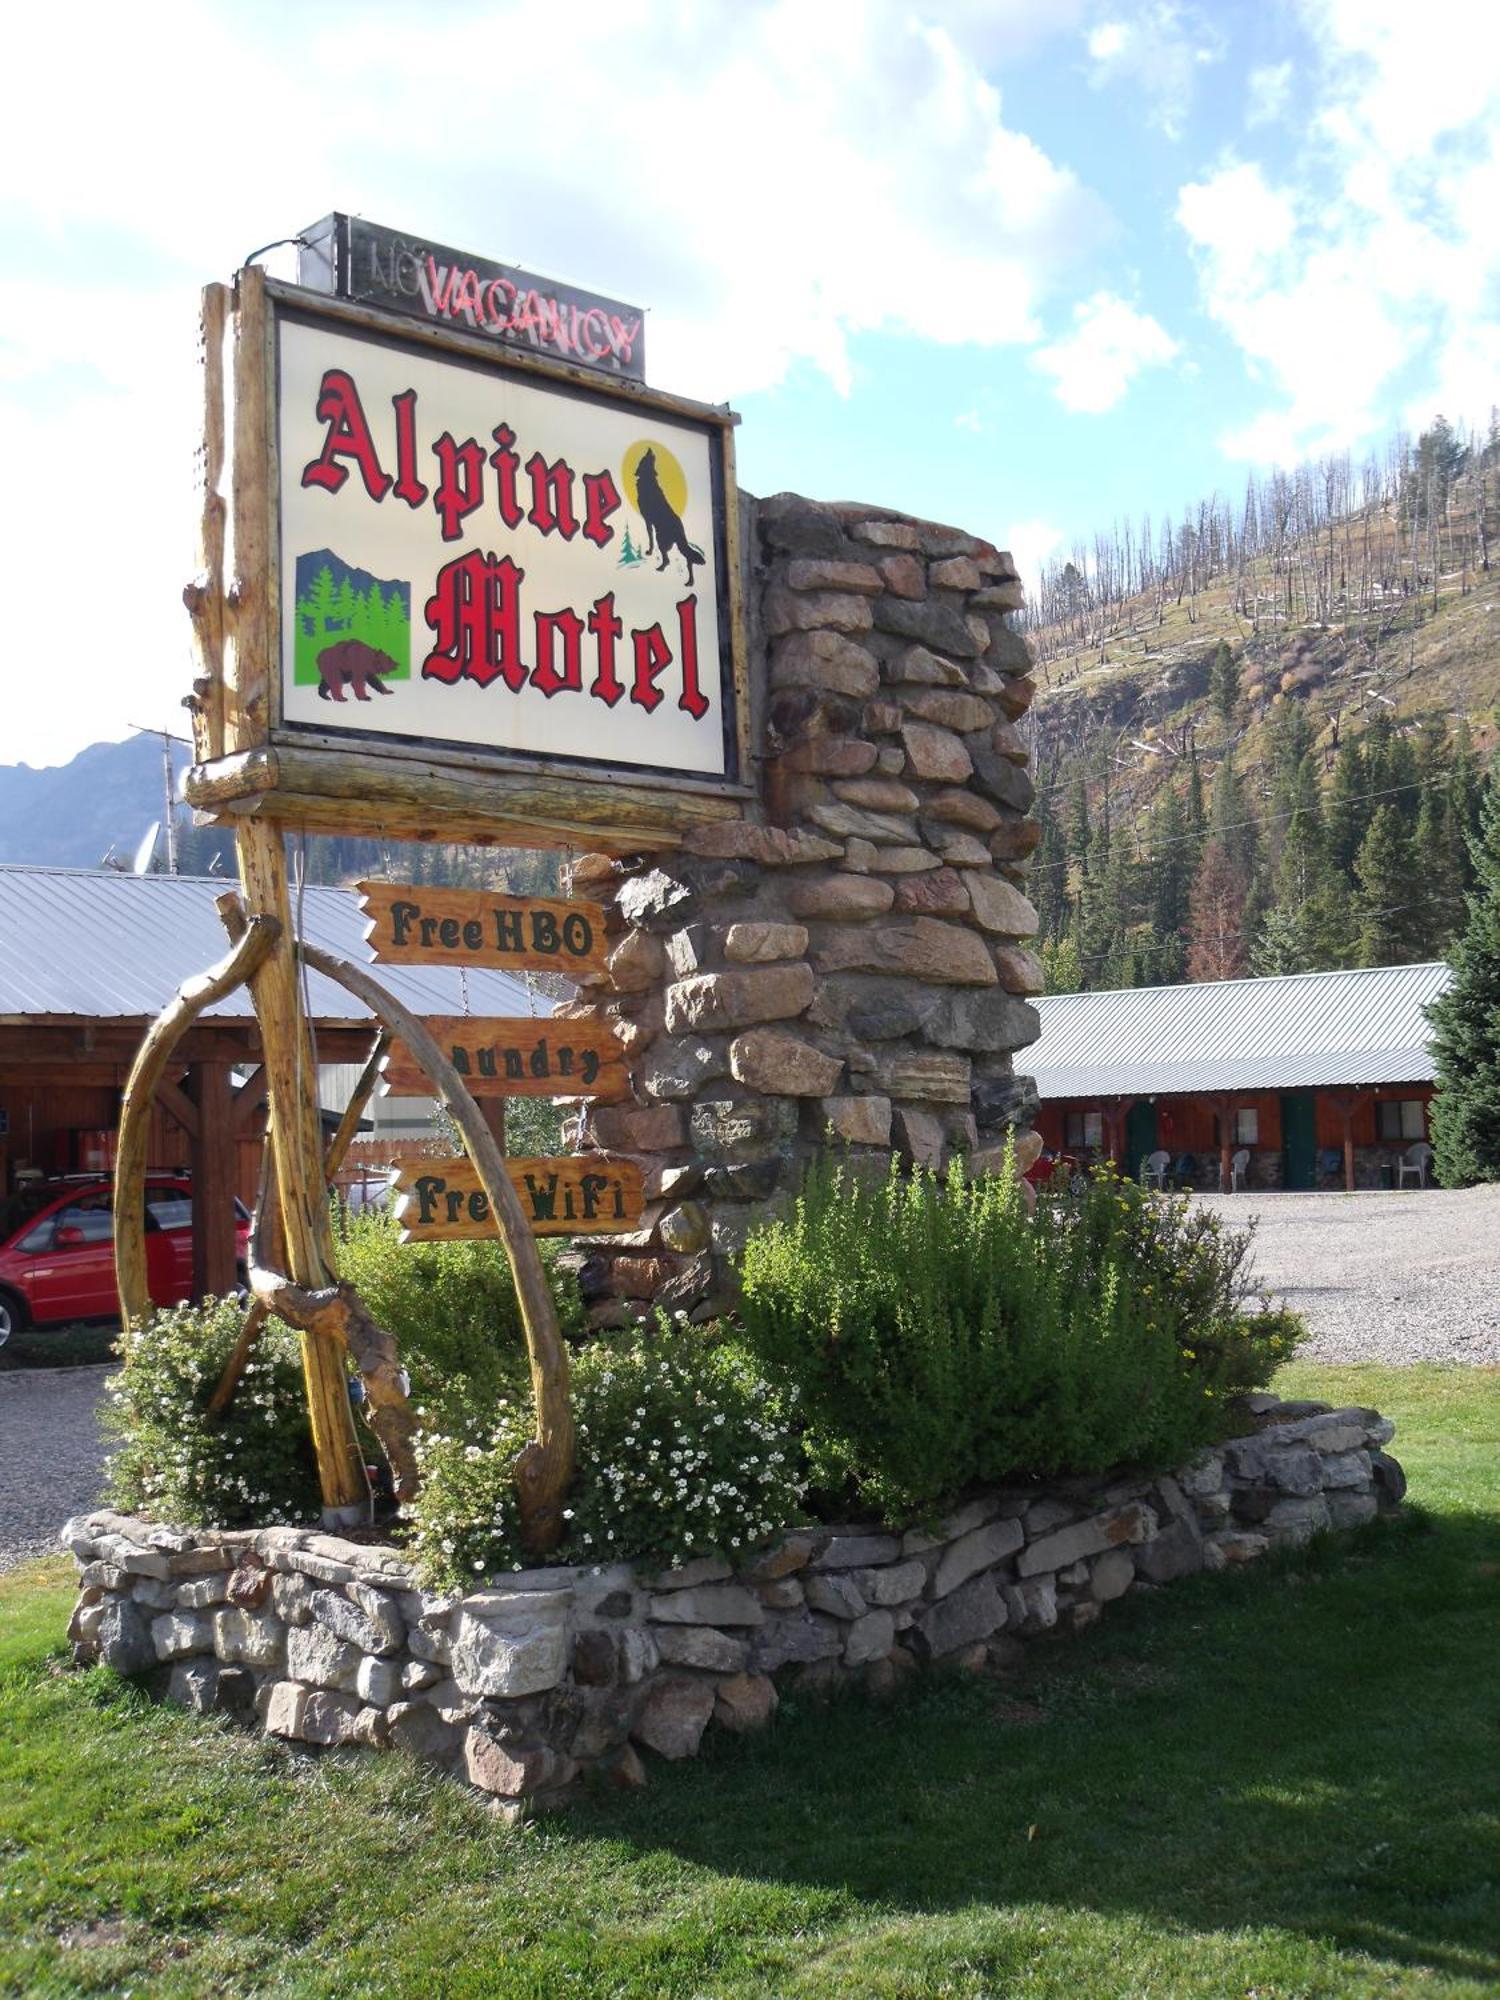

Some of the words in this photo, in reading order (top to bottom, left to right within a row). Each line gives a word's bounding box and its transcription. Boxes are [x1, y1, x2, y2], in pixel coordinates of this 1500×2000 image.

[369, 239, 423, 296] NO
[420, 256, 640, 369] VACANCY
[301, 369, 622, 547] Alpine
[423, 549, 709, 720] Motel
[391, 902, 483, 950] Free
[494, 909, 593, 956] HBO
[421, 1038, 600, 1085] aundry
[415, 1176, 496, 1224] Fre
[524, 1173, 626, 1221] WiFi
